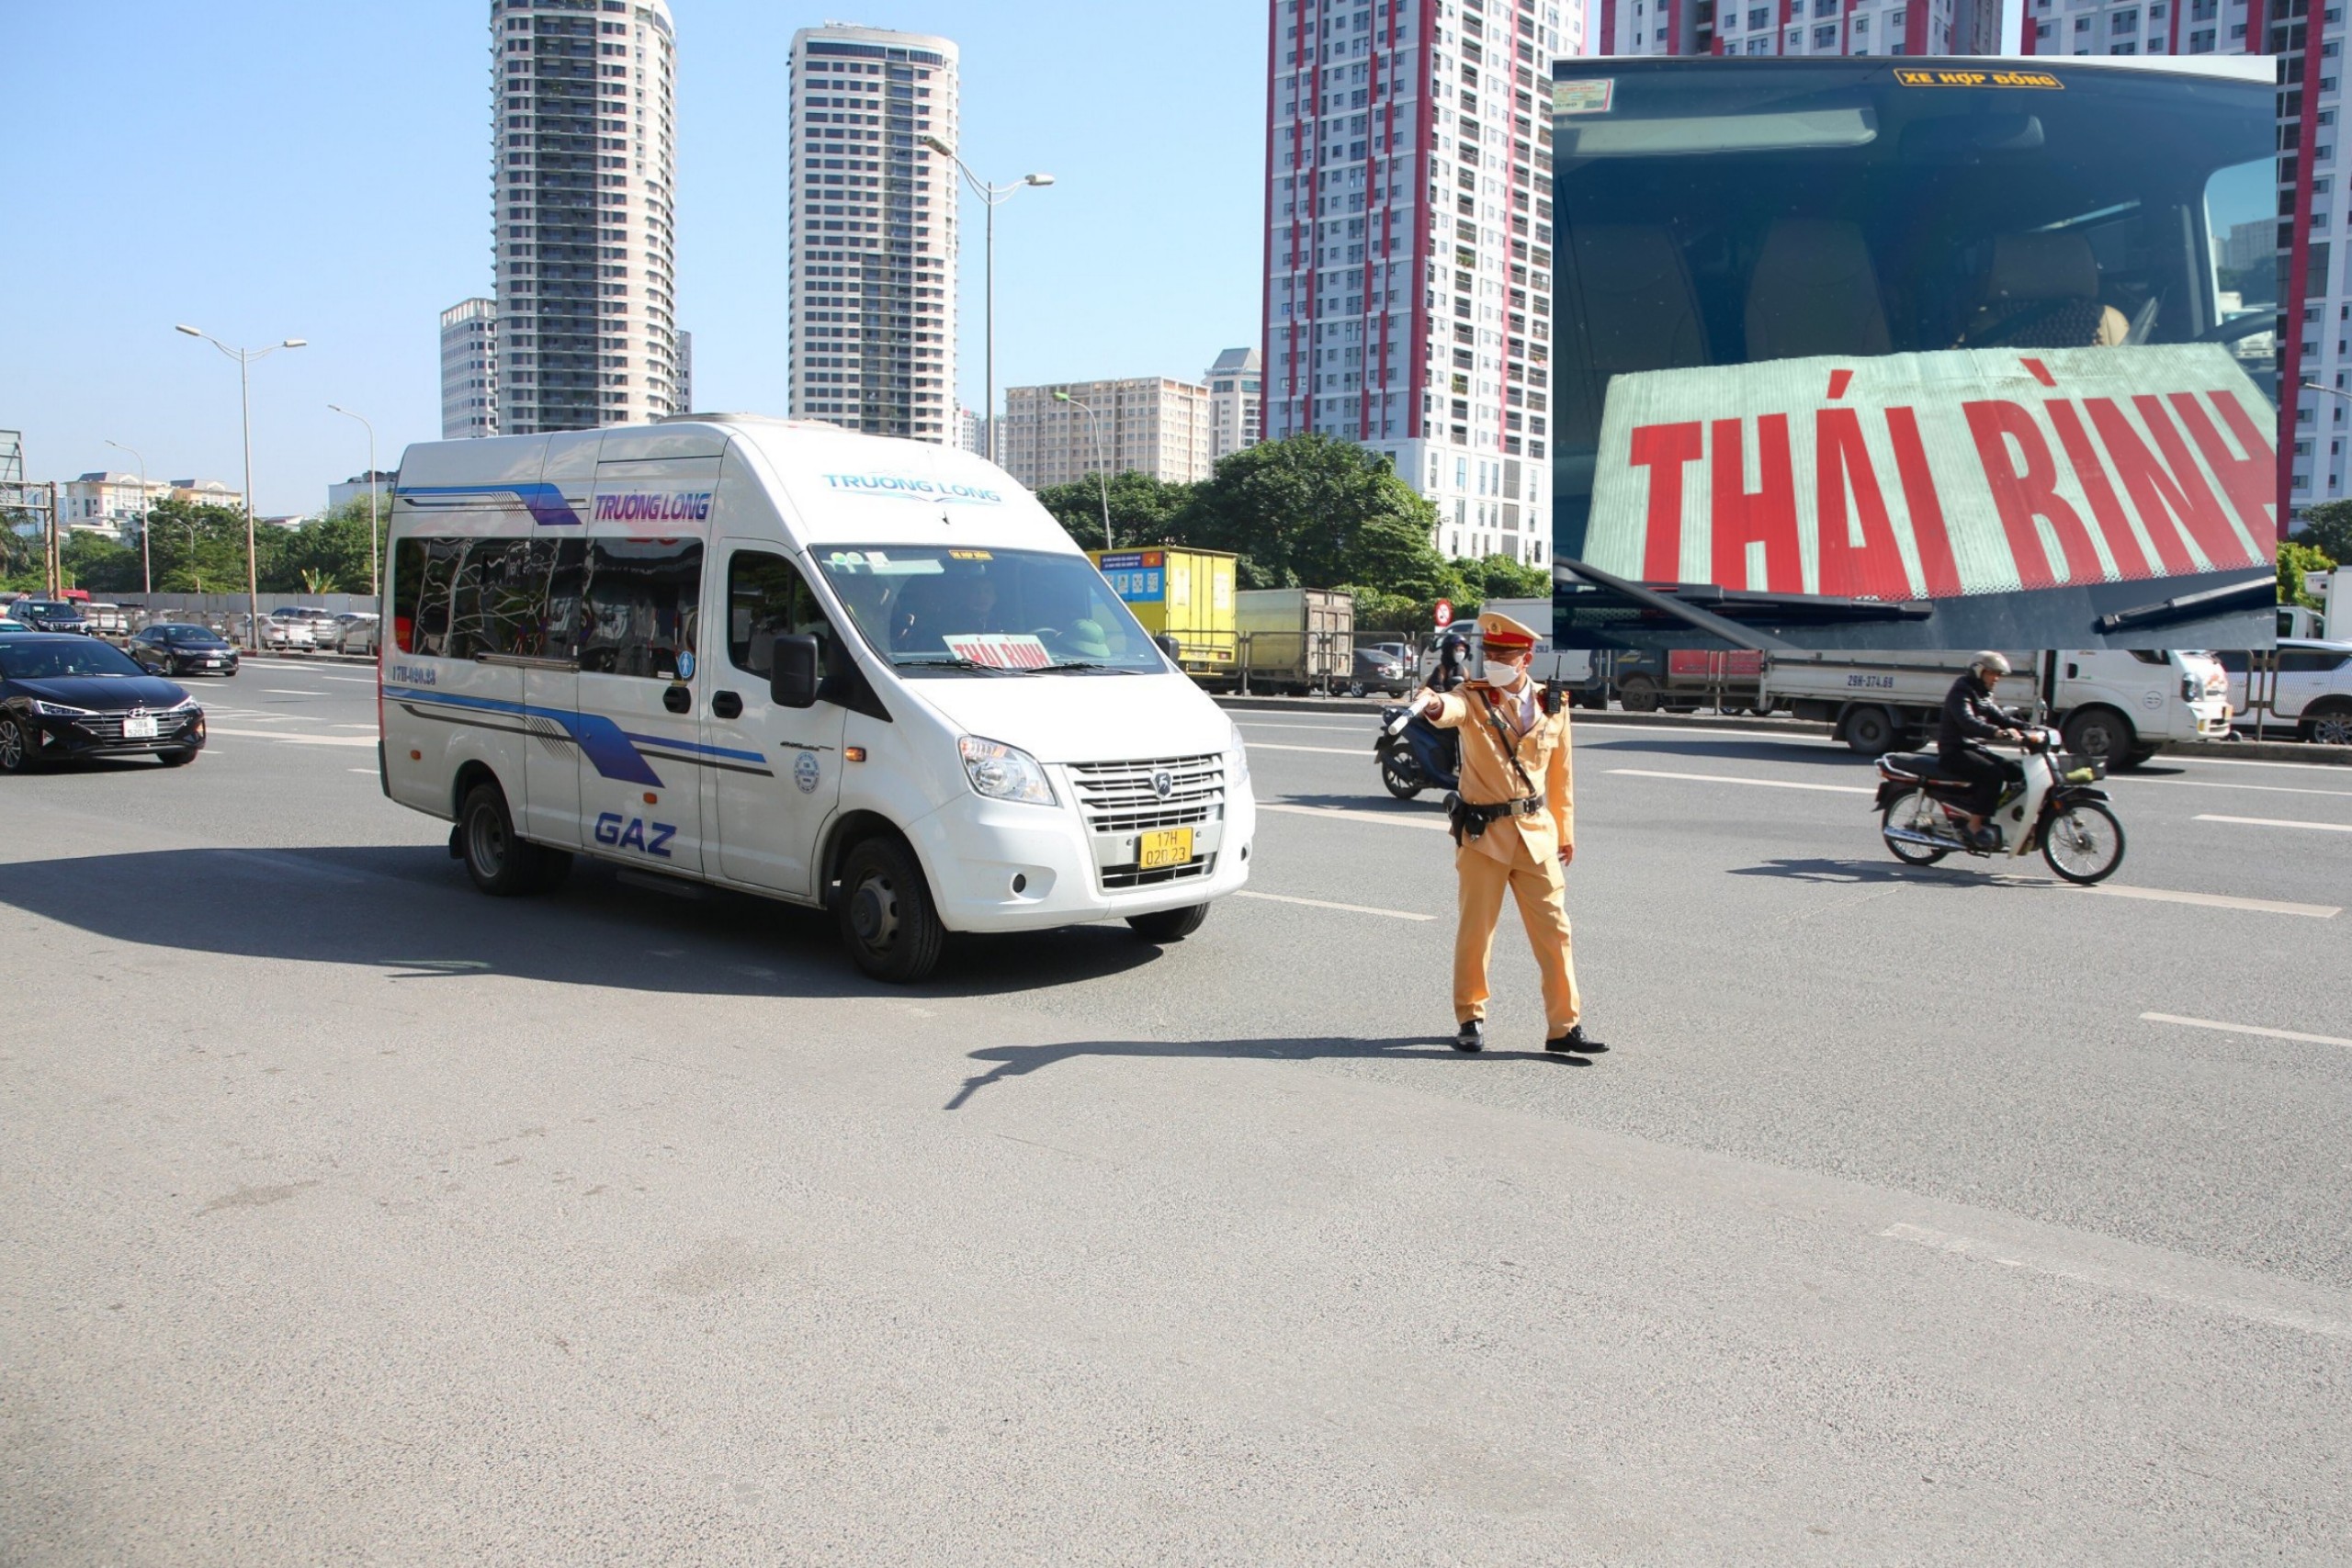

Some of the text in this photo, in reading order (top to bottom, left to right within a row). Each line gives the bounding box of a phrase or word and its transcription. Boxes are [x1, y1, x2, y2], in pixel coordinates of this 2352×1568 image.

[1902, 71, 2058, 86] XE HỢP ĐỒNG
[937, 482, 1002, 502] LONG
[1630, 368, 1963, 600] THÁI
[660, 492, 712, 521] LONG
[953, 637, 1005, 669] THÁI
[594, 811, 678, 858] GAZ
[1157, 830, 1178, 847] 17H
[1146, 846, 1186, 865] 020.23
